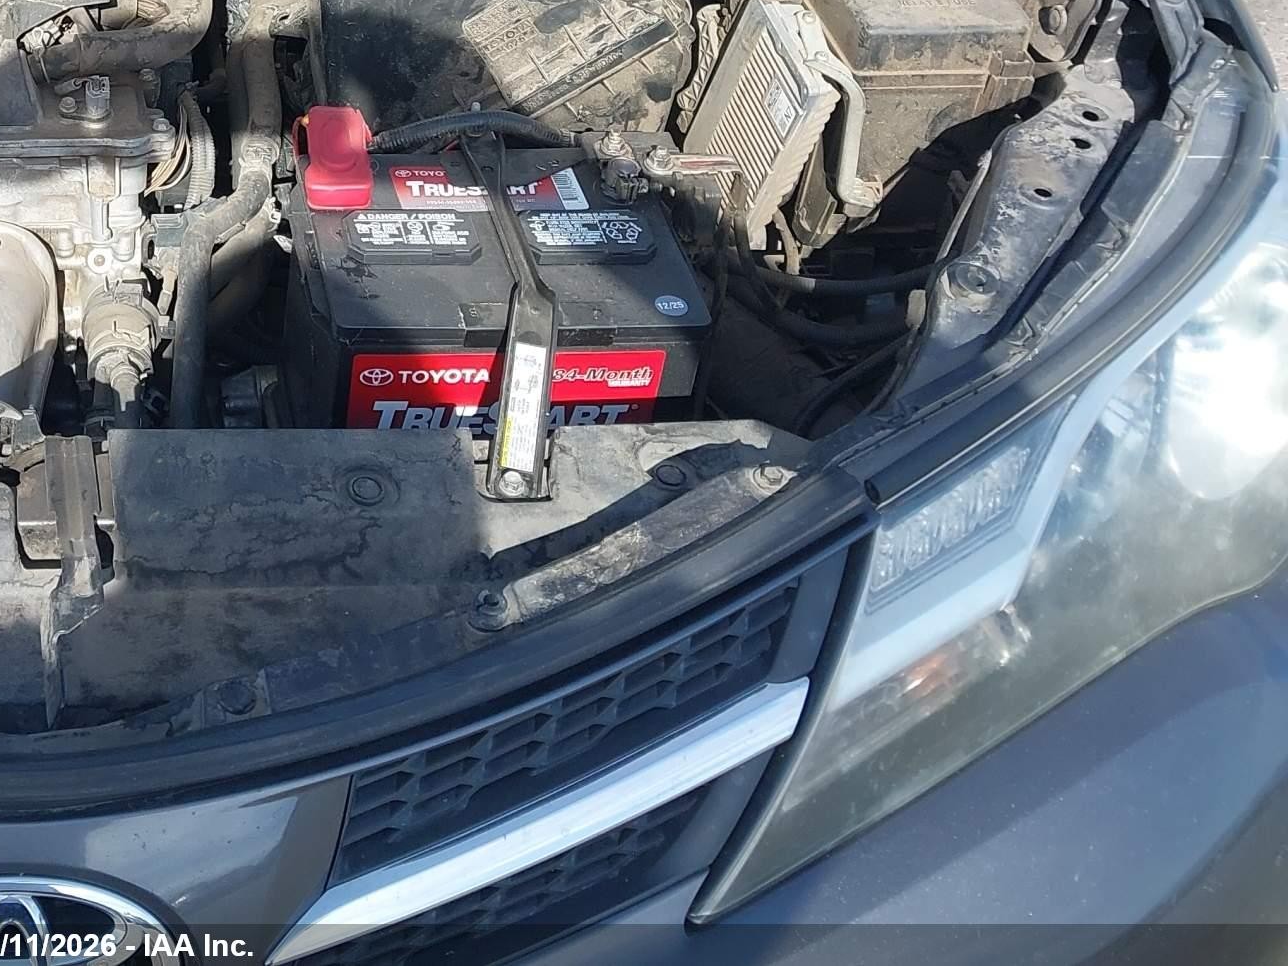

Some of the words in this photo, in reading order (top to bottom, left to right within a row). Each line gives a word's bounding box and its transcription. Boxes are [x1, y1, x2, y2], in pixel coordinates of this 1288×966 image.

[412, 170, 447, 178] TOYO
[657, 301, 685, 310] 12/25
[398, 368, 491, 384] TOYOTA
[551, 365, 654, 383] 84-Month
